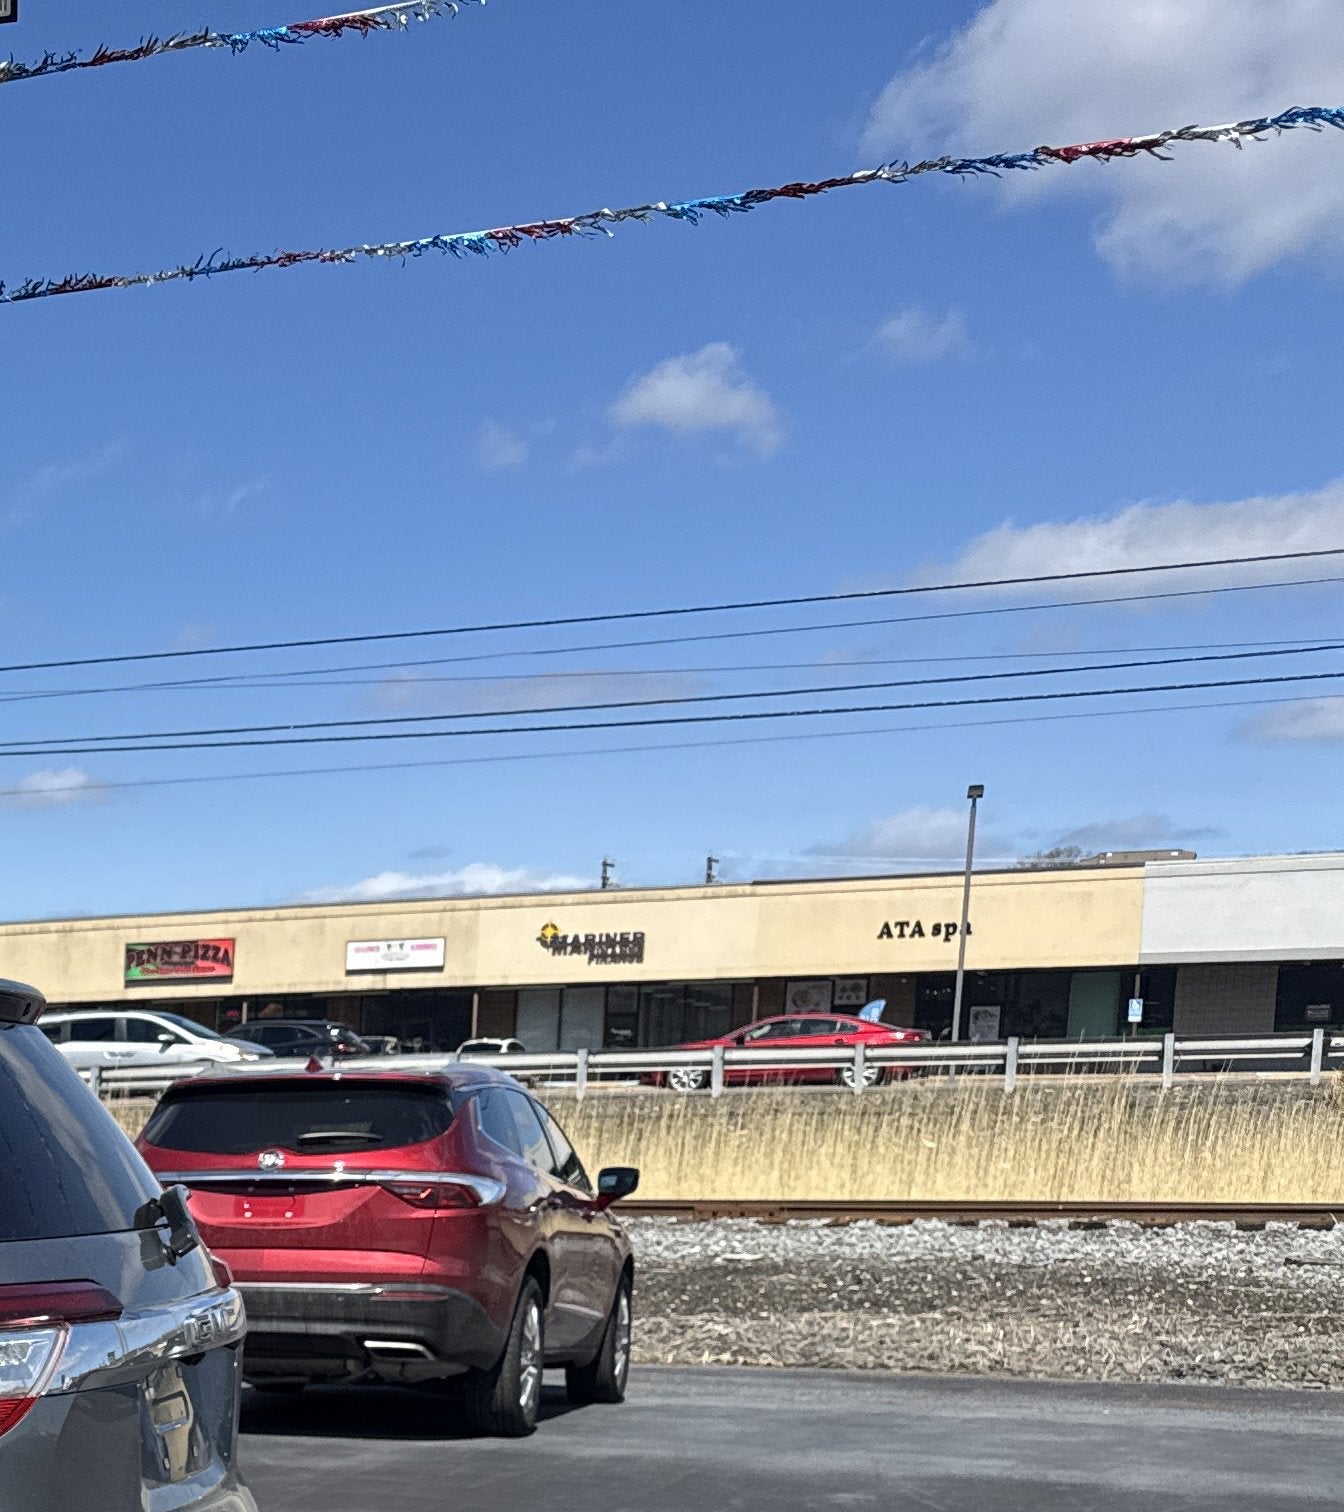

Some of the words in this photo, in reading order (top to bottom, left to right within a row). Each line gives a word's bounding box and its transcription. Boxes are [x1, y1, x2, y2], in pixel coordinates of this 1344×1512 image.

[876, 920, 925, 939] ATA
[126, 945, 173, 970] PENN
[180, 942, 231, 967] PIZZA
